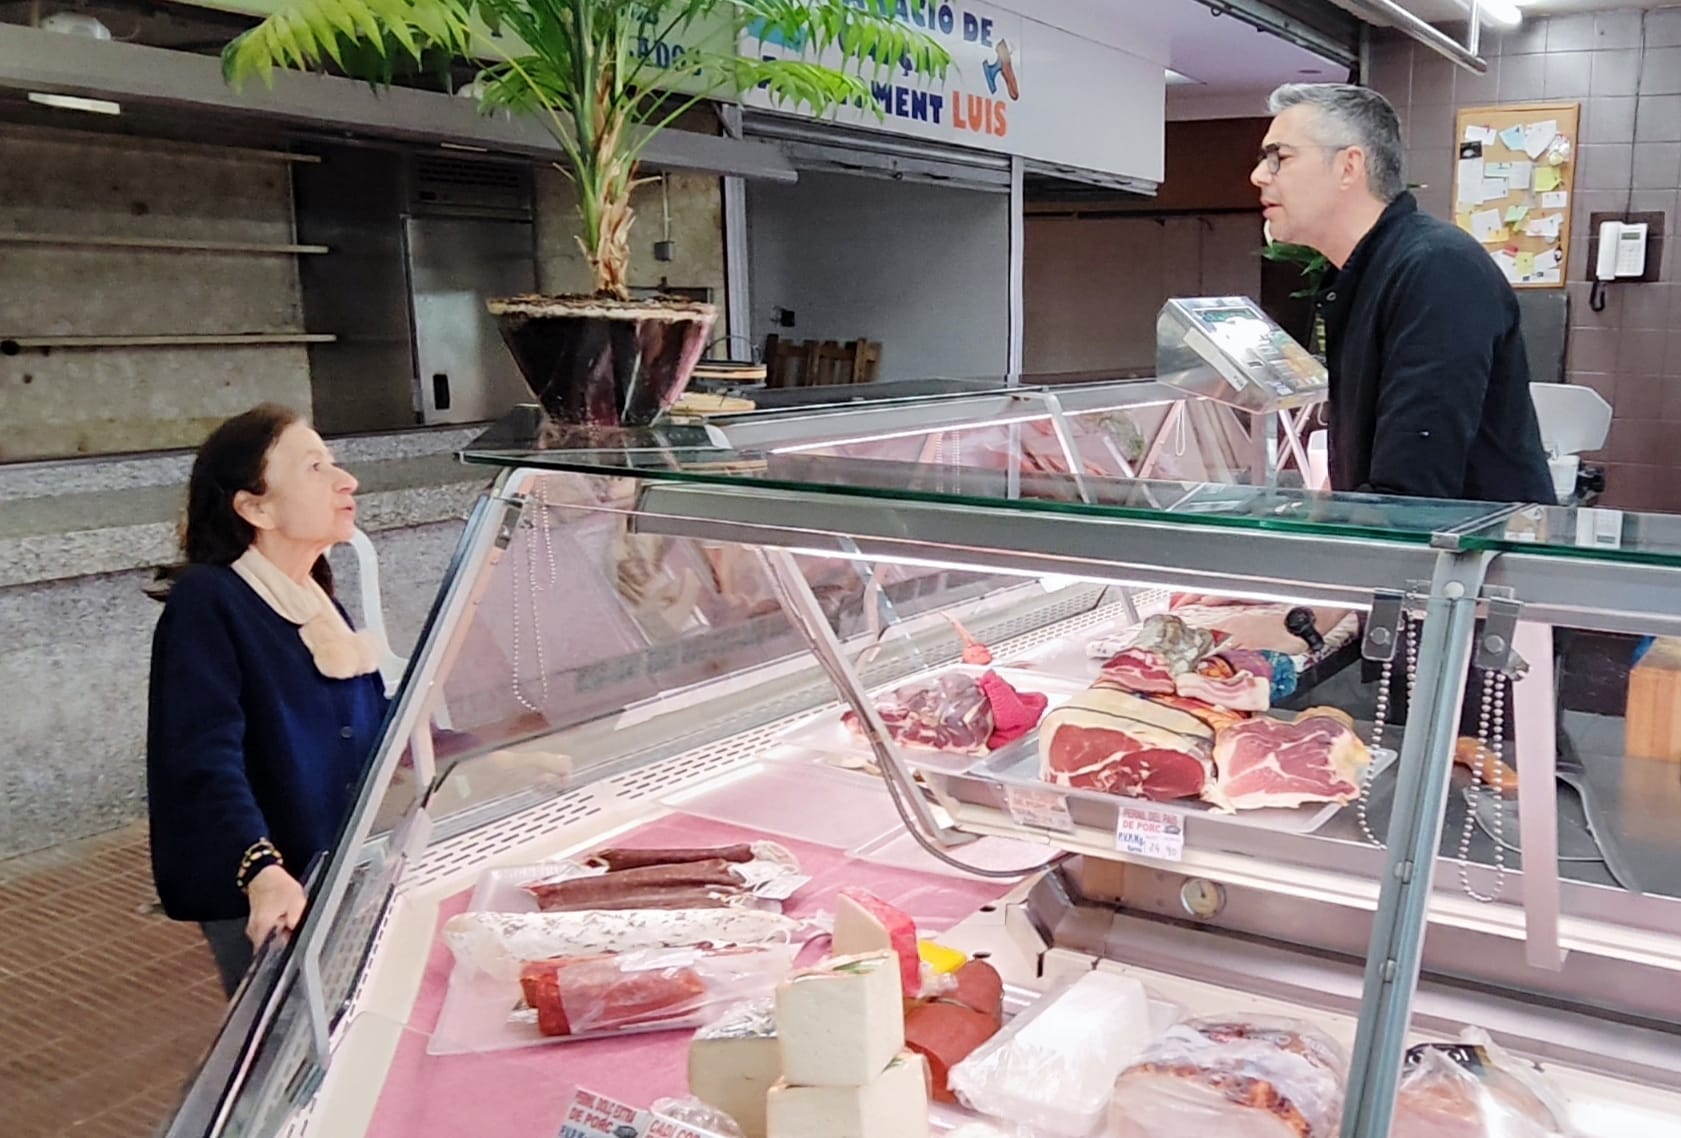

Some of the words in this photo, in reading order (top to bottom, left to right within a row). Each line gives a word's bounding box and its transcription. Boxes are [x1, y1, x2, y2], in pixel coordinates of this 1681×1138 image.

[963, 12, 993, 48] DE
[952, 90, 1007, 137] LUIS
[1122, 820, 1134, 830] DE
[568, 1107, 584, 1122] DE
[584, 1113, 614, 1134] PORC
